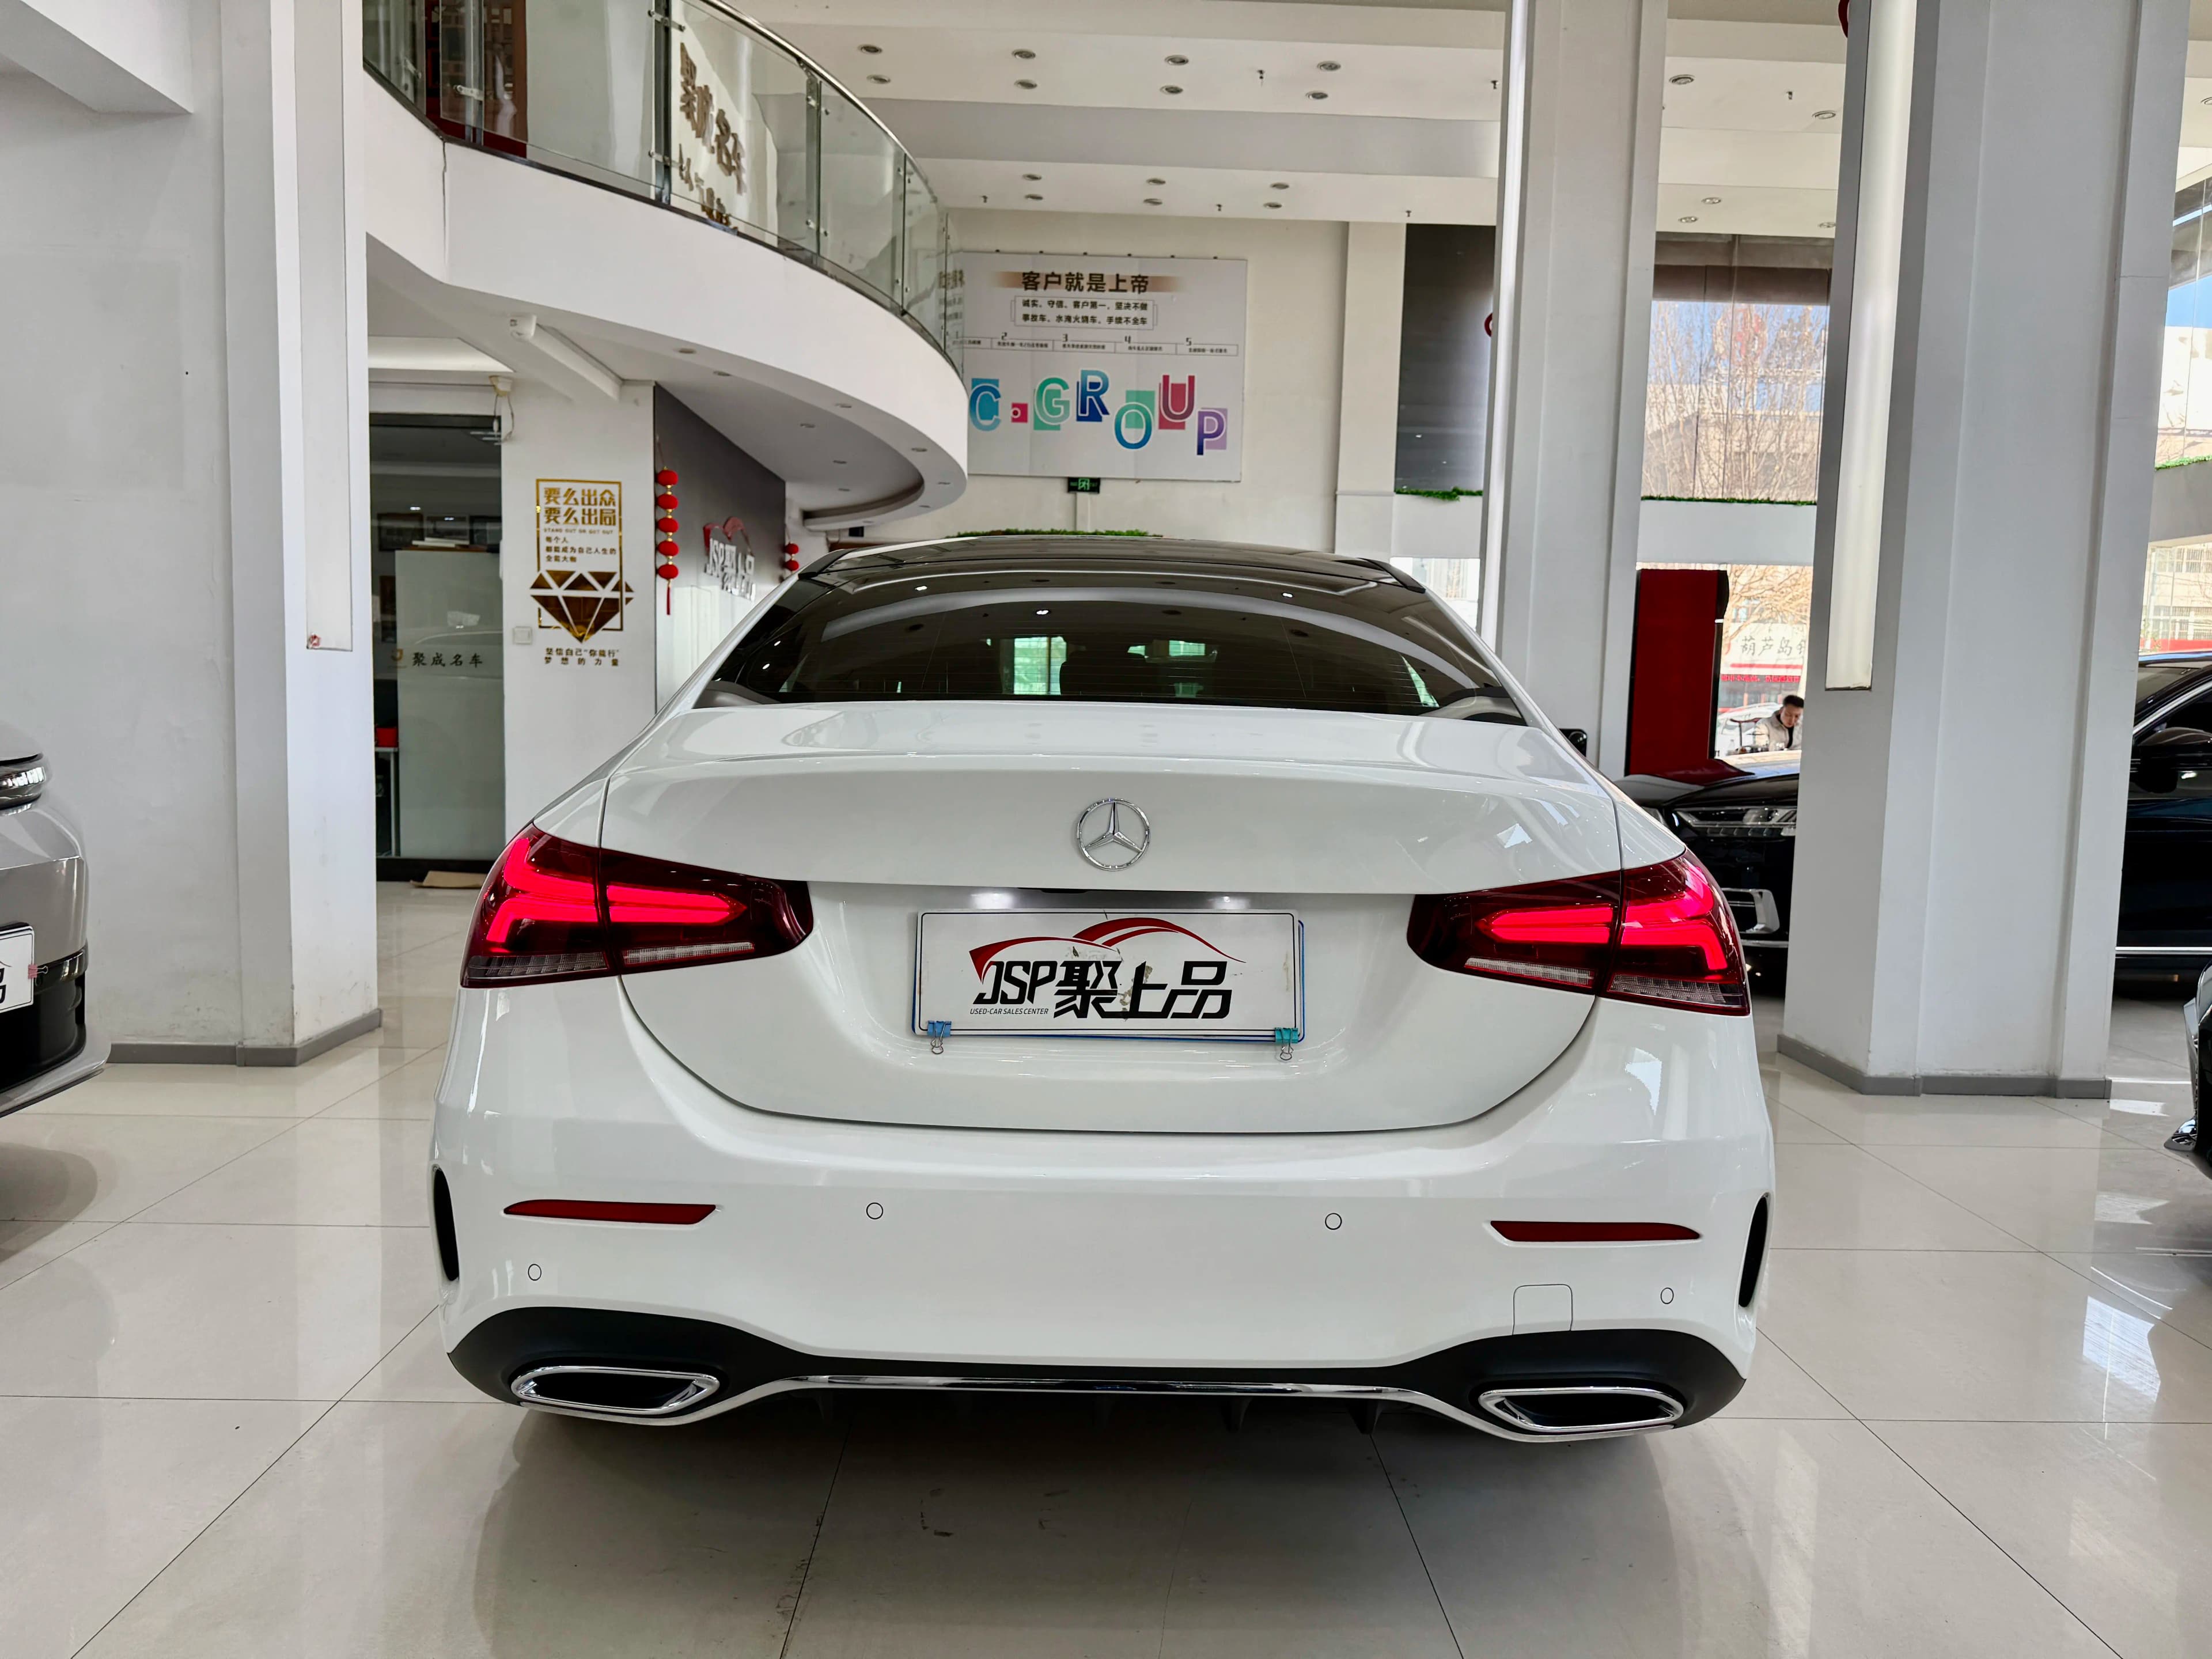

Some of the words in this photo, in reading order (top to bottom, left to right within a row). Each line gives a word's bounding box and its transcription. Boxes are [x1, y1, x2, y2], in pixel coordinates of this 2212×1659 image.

[1022, 271, 1149, 294] 客户就是上帝
[1001, 332, 1007, 340] 2
[1063, 334, 1068, 342] 3
[1186, 338, 1192, 346] 5
[544, 487, 616, 506] 要么出众
[544, 507, 616, 526] 要么出局
[412, 652, 483, 668] 聚成名车
